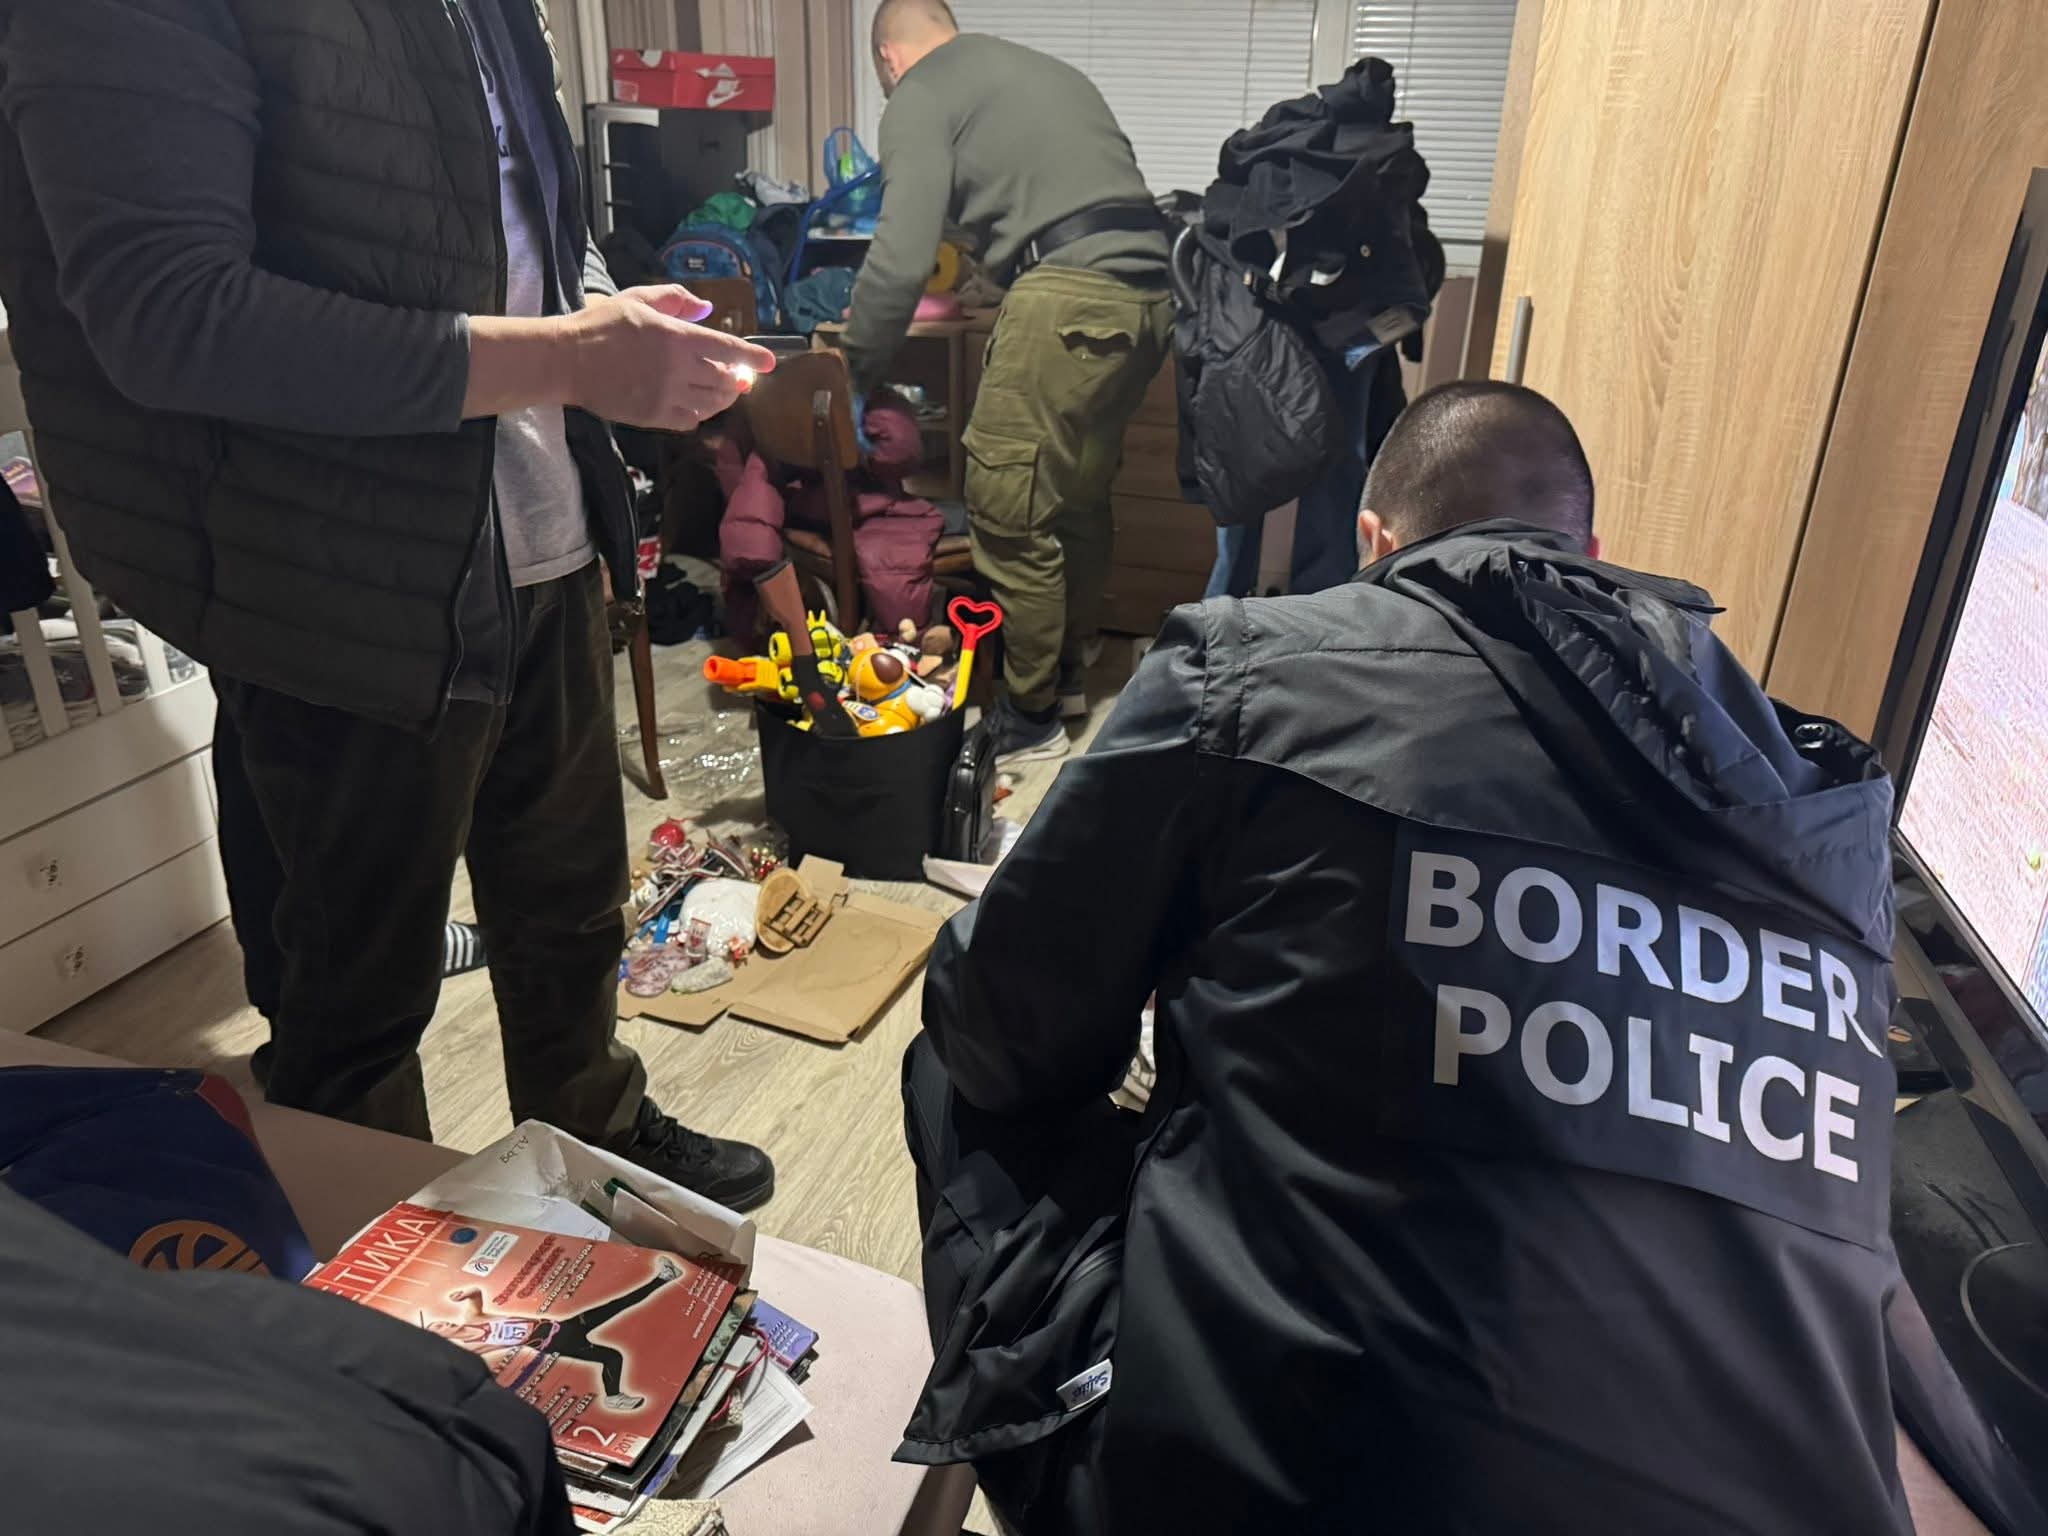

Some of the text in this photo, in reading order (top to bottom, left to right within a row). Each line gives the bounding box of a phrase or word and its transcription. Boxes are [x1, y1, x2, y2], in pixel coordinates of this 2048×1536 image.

[1404, 850, 1883, 1058] BORDER
[1433, 984, 1861, 1183] POLICE
[322, 1217, 437, 1300] ТИКА
[573, 1425, 617, 1447] 2
[614, 1433, 639, 1454] 2011
